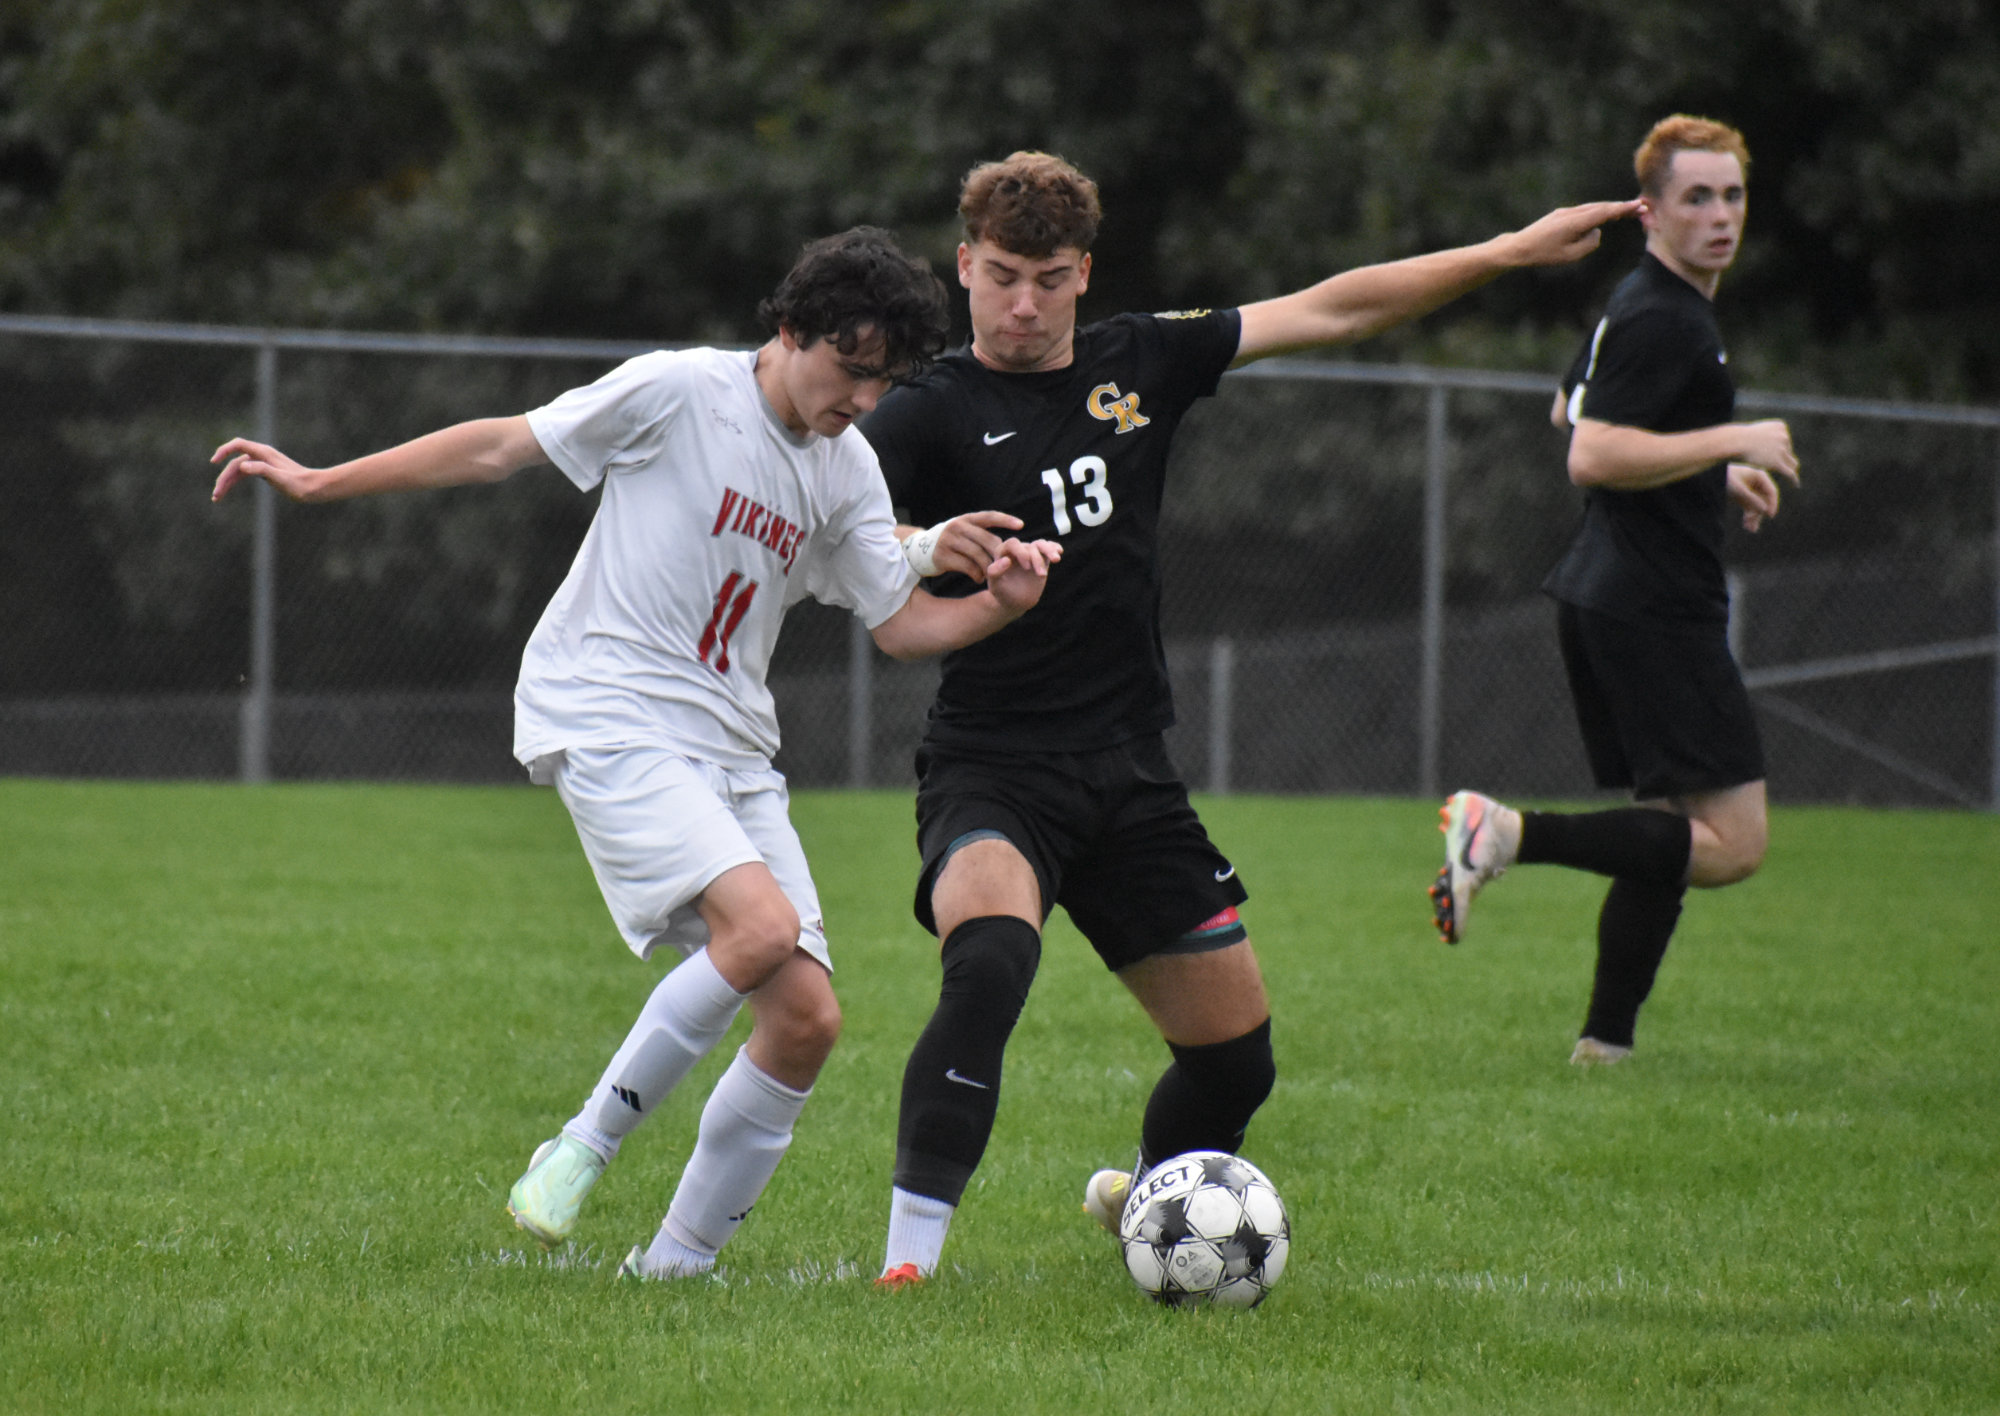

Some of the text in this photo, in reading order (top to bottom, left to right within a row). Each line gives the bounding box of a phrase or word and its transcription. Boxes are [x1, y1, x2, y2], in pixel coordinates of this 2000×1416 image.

[711, 486, 806, 577] VIKINGS
[1041, 455, 1114, 536] 13
[697, 568, 759, 676] 11
[1123, 1165, 1190, 1230] SELECT
